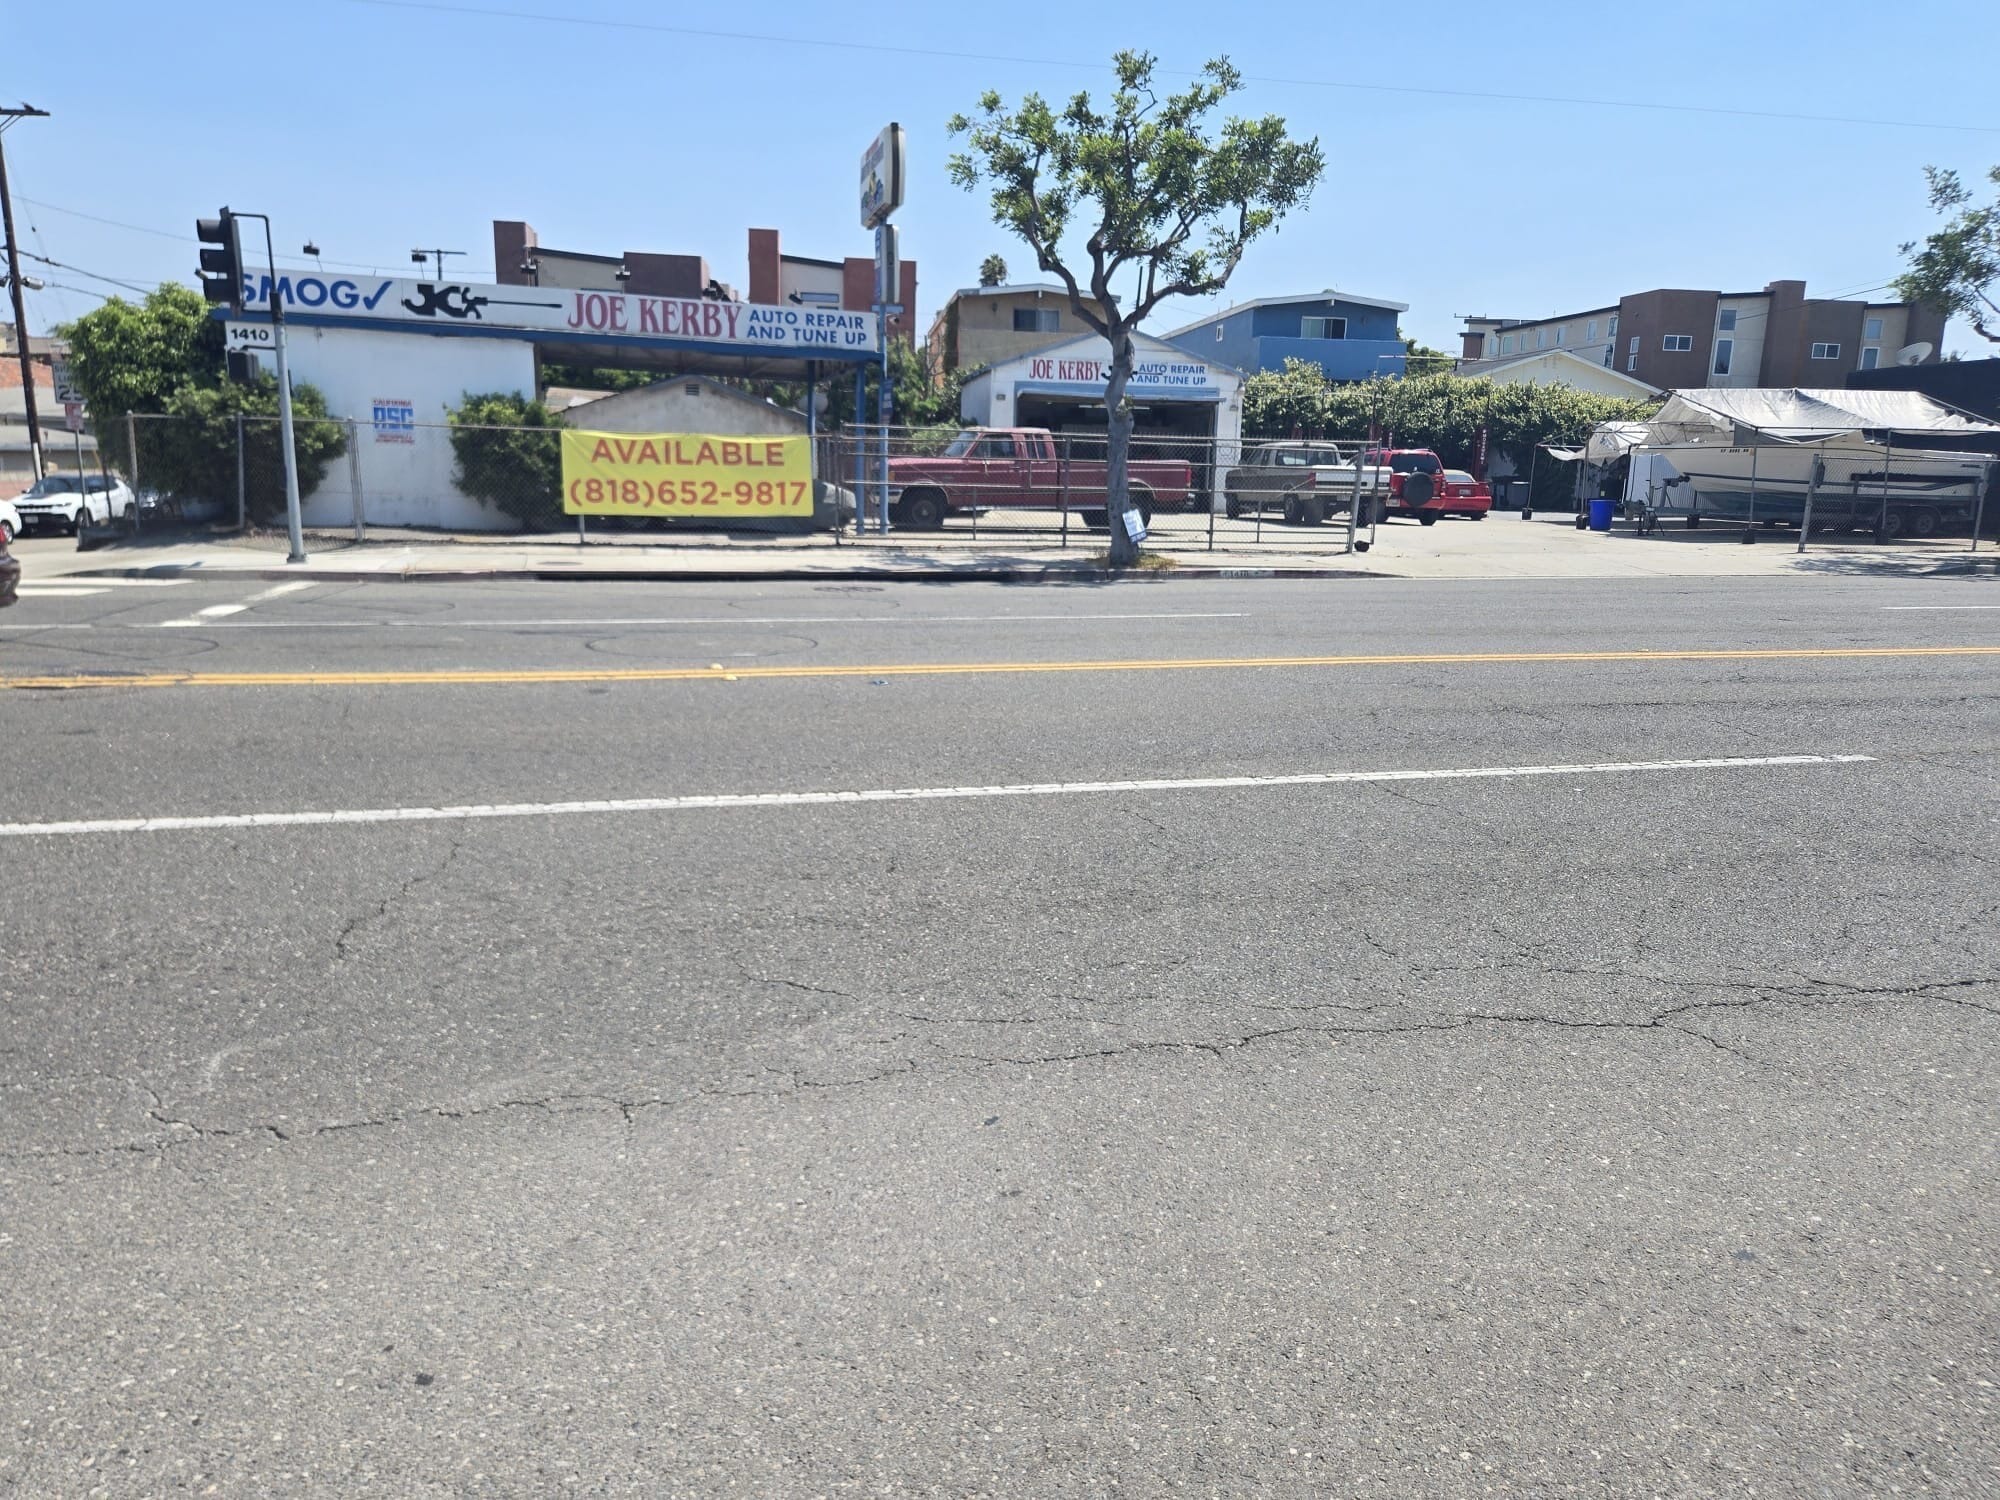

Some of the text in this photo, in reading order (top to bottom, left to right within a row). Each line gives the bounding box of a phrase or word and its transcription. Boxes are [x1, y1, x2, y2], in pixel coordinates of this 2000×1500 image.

[242, 273, 360, 309] SMOG
[567, 293, 742, 339] JOE KERBY
[749, 309, 864, 330] AUTO REPAIR
[231, 328, 269, 341] 1410
[747, 325, 867, 345] AND TUNE UP
[1029, 359, 1054, 379] JOE
[1058, 360, 1102, 382] KERBY
[1137, 374, 1160, 384] AND
[1163, 375, 1189, 385] TUNE
[1193, 376, 1207, 386] UP
[1139, 363, 1168, 374] AUTO
[1170, 364, 1206, 375] REPAIR
[591, 439, 785, 466] AVAILABLE
[570, 478, 807, 508] (818)652-9817
